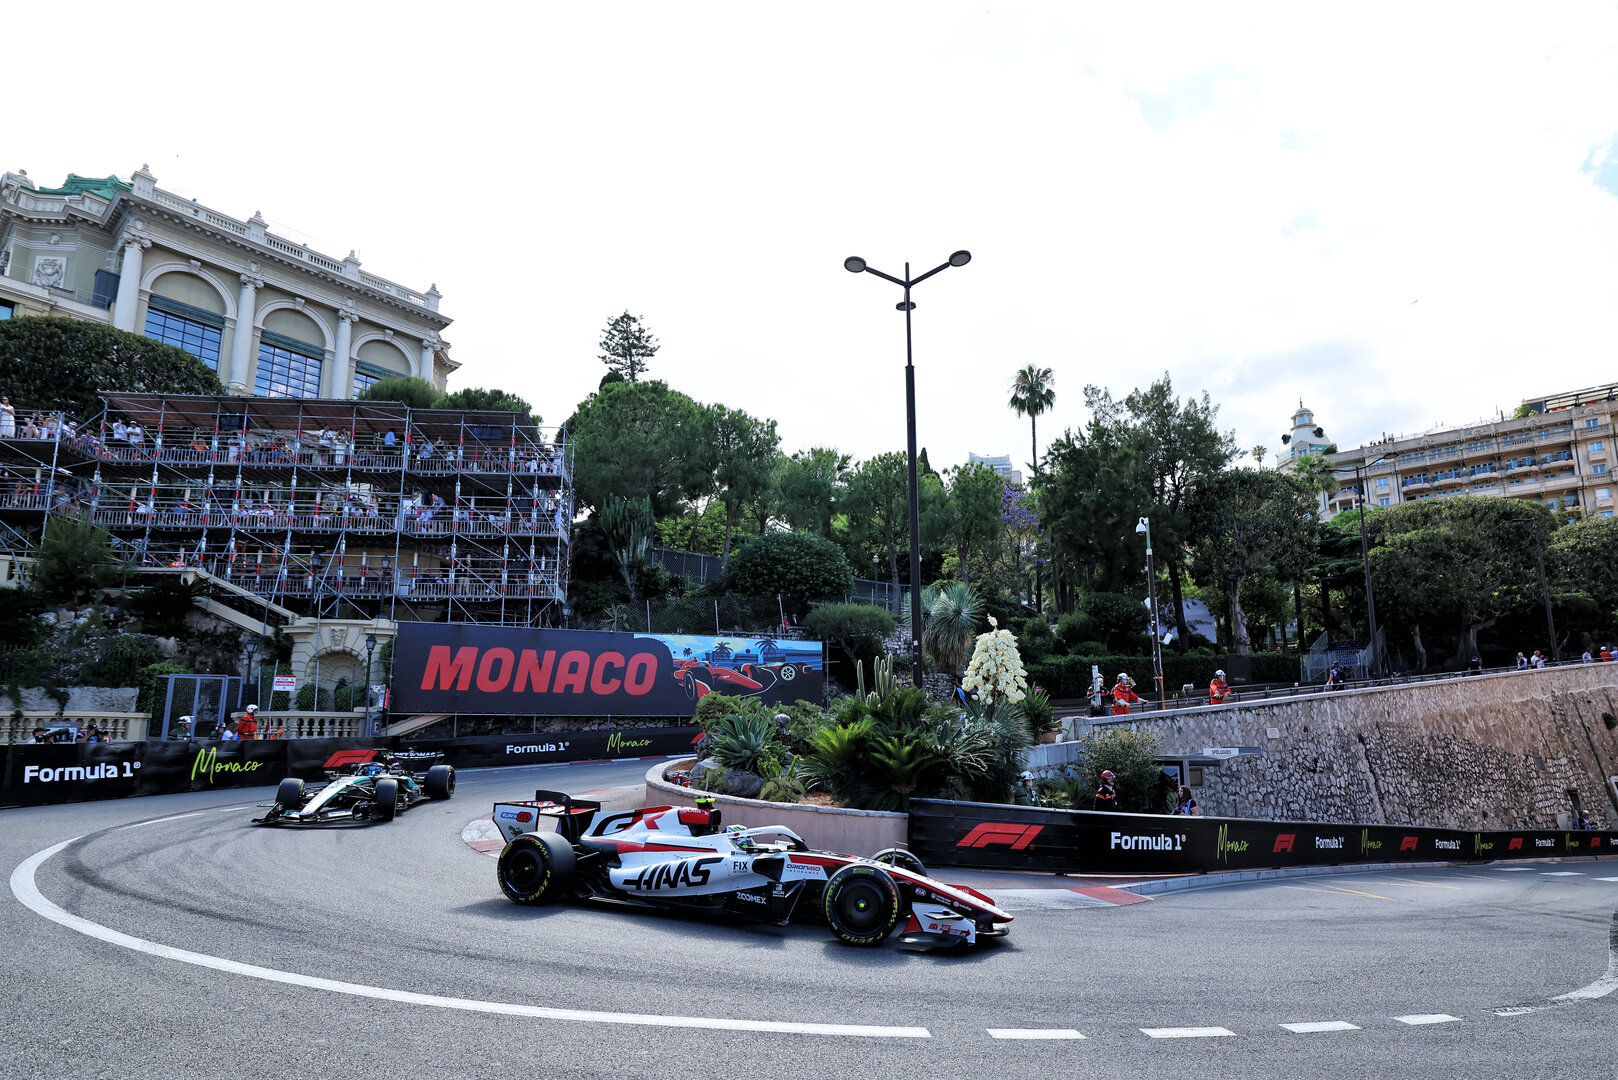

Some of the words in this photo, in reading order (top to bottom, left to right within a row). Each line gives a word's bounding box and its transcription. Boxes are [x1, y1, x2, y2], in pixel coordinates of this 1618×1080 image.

[420, 645, 658, 696] MONACO
[505, 742, 556, 755] Formula
[606, 731, 653, 754] Monaco
[24, 762, 118, 783] Formula
[191, 746, 264, 784] Monaco
[1110, 831, 1173, 851] Formula
[1216, 823, 1250, 864] Monaco
[1315, 836, 1339, 849] Formula
[1435, 838, 1456, 850] Formula
[622, 856, 726, 891] HAAS
[732, 860, 749, 871] FIX
[736, 891, 767, 905] ZOOMEX
